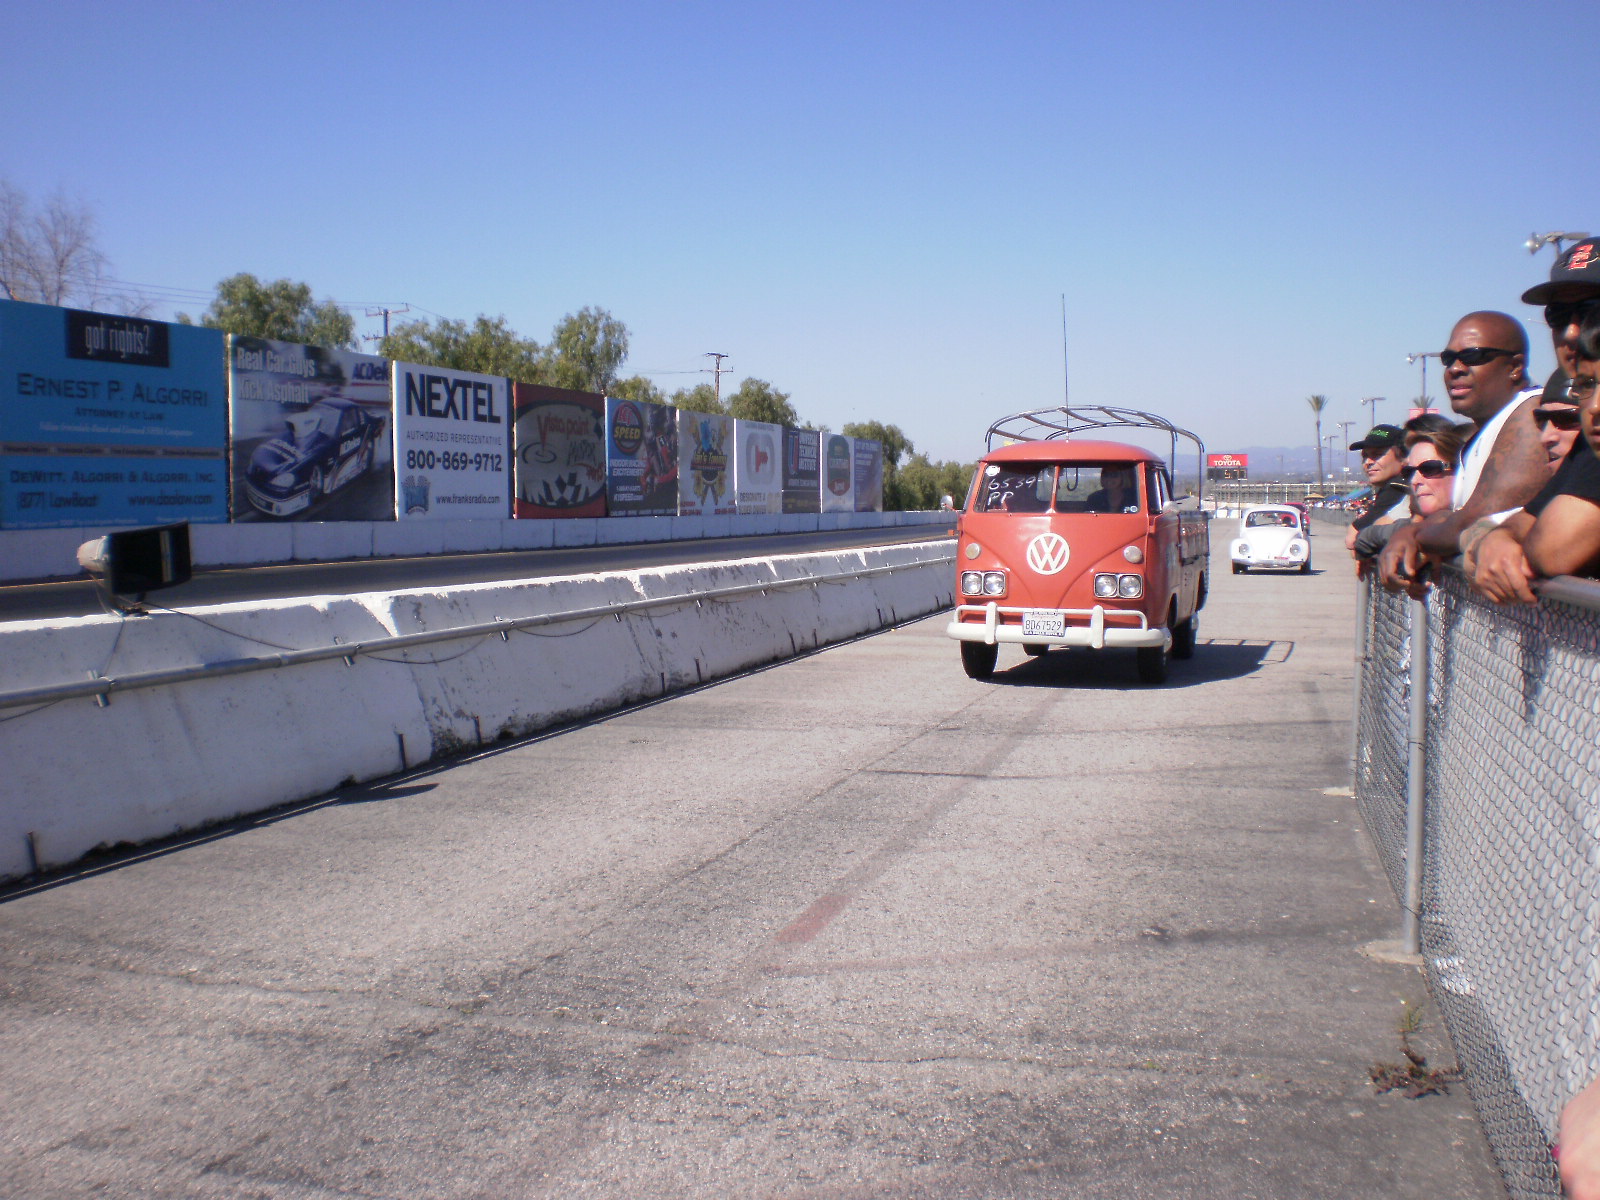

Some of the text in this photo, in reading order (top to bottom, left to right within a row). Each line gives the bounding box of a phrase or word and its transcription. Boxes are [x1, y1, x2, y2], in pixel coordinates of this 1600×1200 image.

[85, 320, 150, 359] got rights?
[237, 347, 316, 378] Real Car Guys
[17, 373, 208, 407] ERNEST P. ALGORRI
[238, 377, 310, 404] Kick Asphalt
[405, 372, 501, 424] NEXTEL
[406, 430, 502, 446] AUTHORIZED REPRESENTATIVE
[614, 426, 641, 440] SPEED
[406, 449, 502, 472] 800-869-9712
[71, 470, 123, 484] ALGORRI
[128, 471, 137, 483] &
[436, 493, 500, 505] www.franksradio.com
